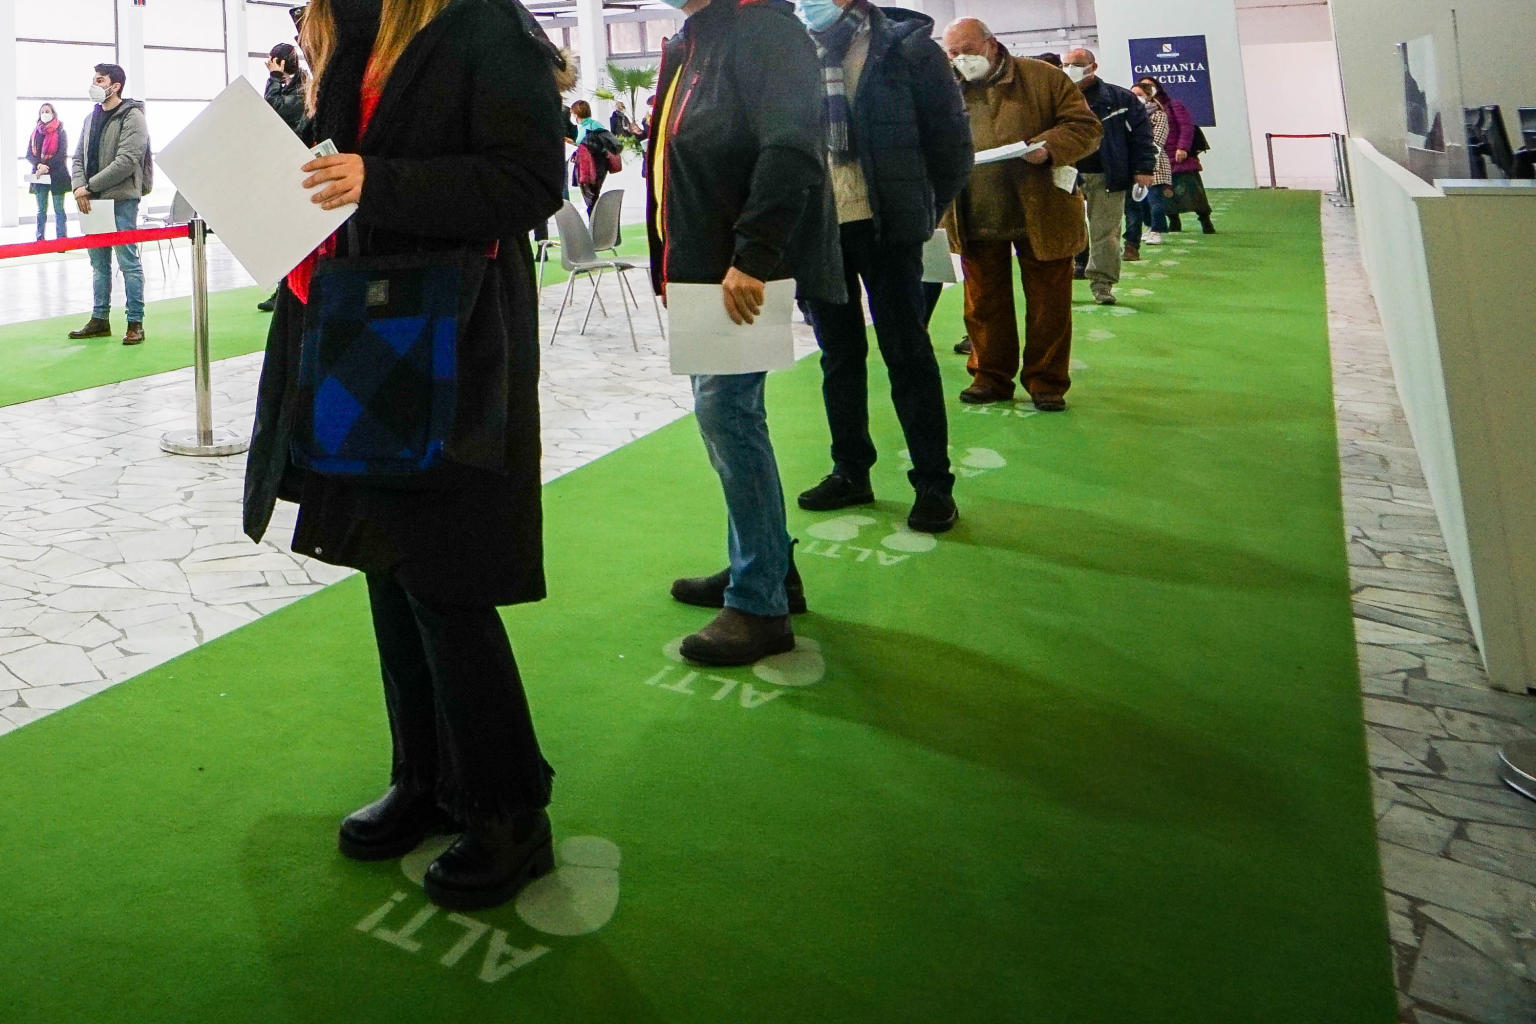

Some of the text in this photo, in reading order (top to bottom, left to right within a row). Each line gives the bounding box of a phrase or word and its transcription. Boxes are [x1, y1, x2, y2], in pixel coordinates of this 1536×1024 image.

[1134, 63, 1206, 74] CAMPANIA
[1154, 75, 1197, 83] CURA
[644, 665, 786, 708] ALT!
[354, 890, 552, 983] ALT!
